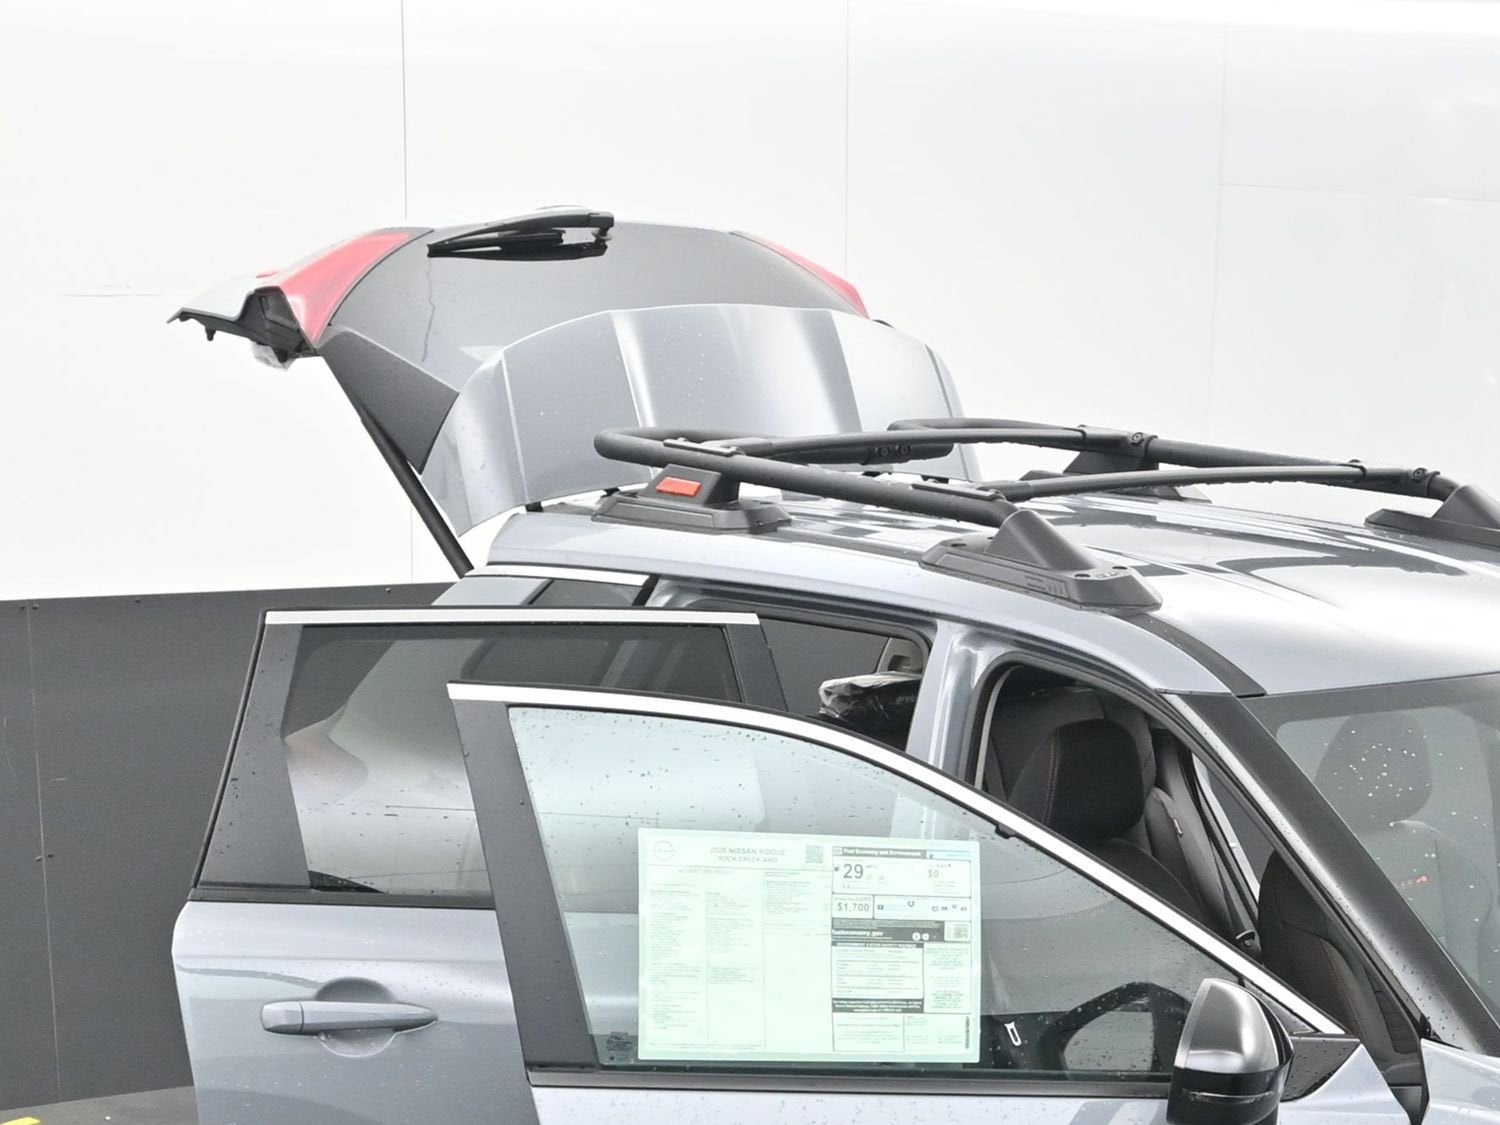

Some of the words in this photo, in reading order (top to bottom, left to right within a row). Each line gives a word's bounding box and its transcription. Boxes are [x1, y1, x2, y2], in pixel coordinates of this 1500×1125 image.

[843, 863, 864, 879] 29
[928, 869, 939, 878] $0
[837, 902, 870, 912] $1,700
